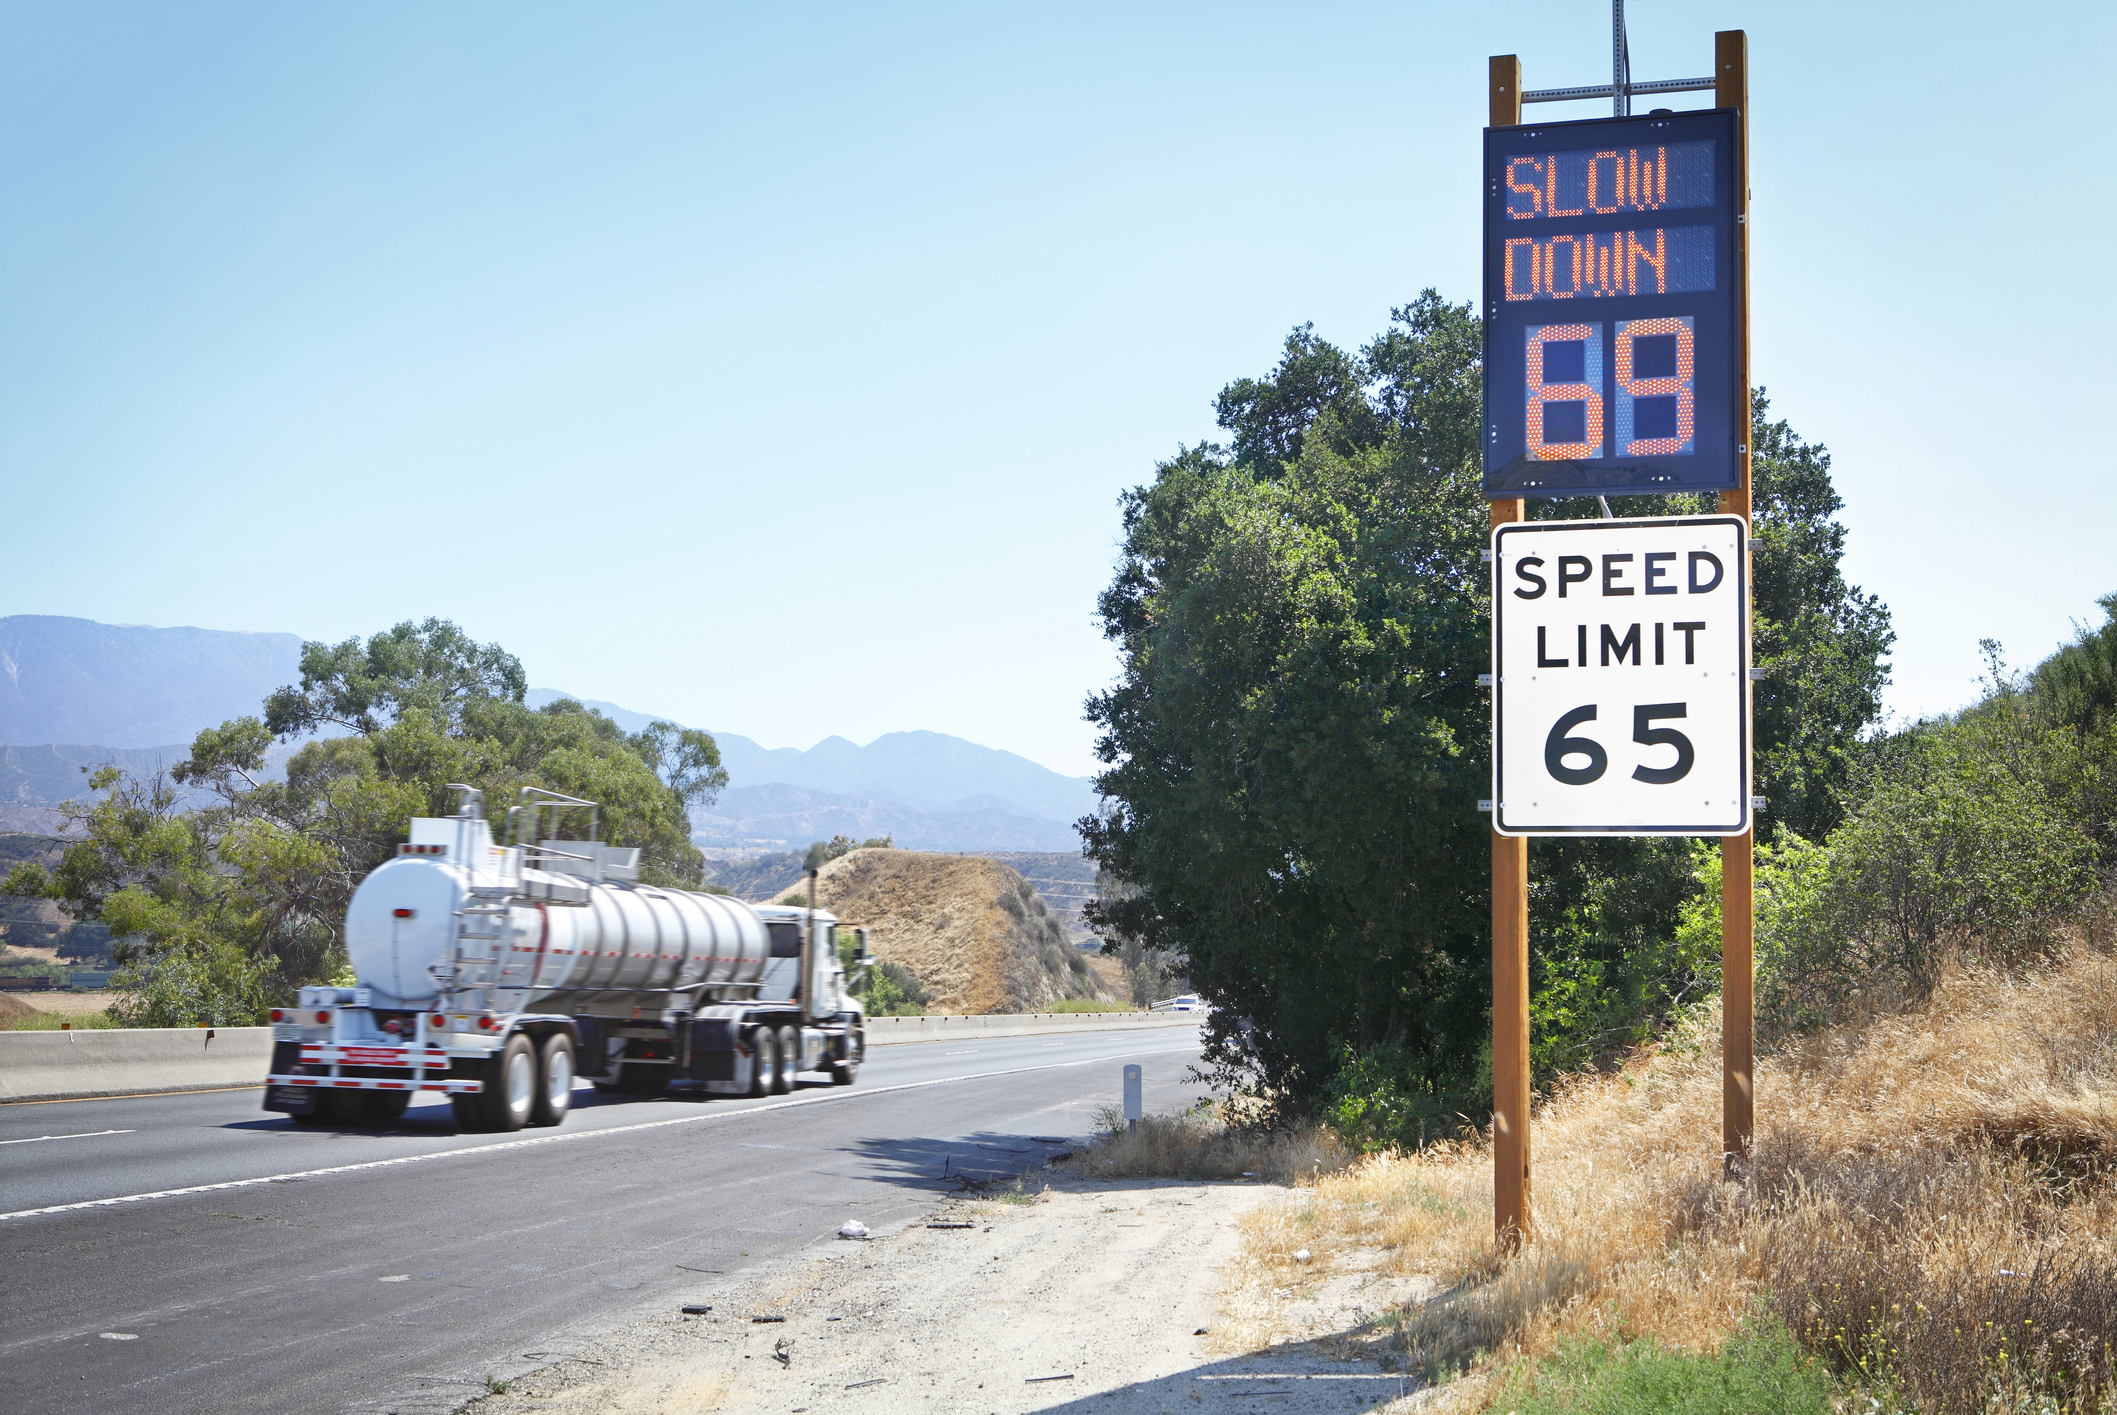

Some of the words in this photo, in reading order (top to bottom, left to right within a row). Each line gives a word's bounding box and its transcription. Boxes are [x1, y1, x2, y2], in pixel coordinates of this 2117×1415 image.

[1507, 147, 1666, 219] SLOW
[1504, 228, 1665, 301] DOWN
[1526, 318, 1695, 462] 69
[1513, 551, 1724, 600] SPEED
[1537, 621, 1706, 668] LIMIT
[1544, 702, 1695, 786] 65
